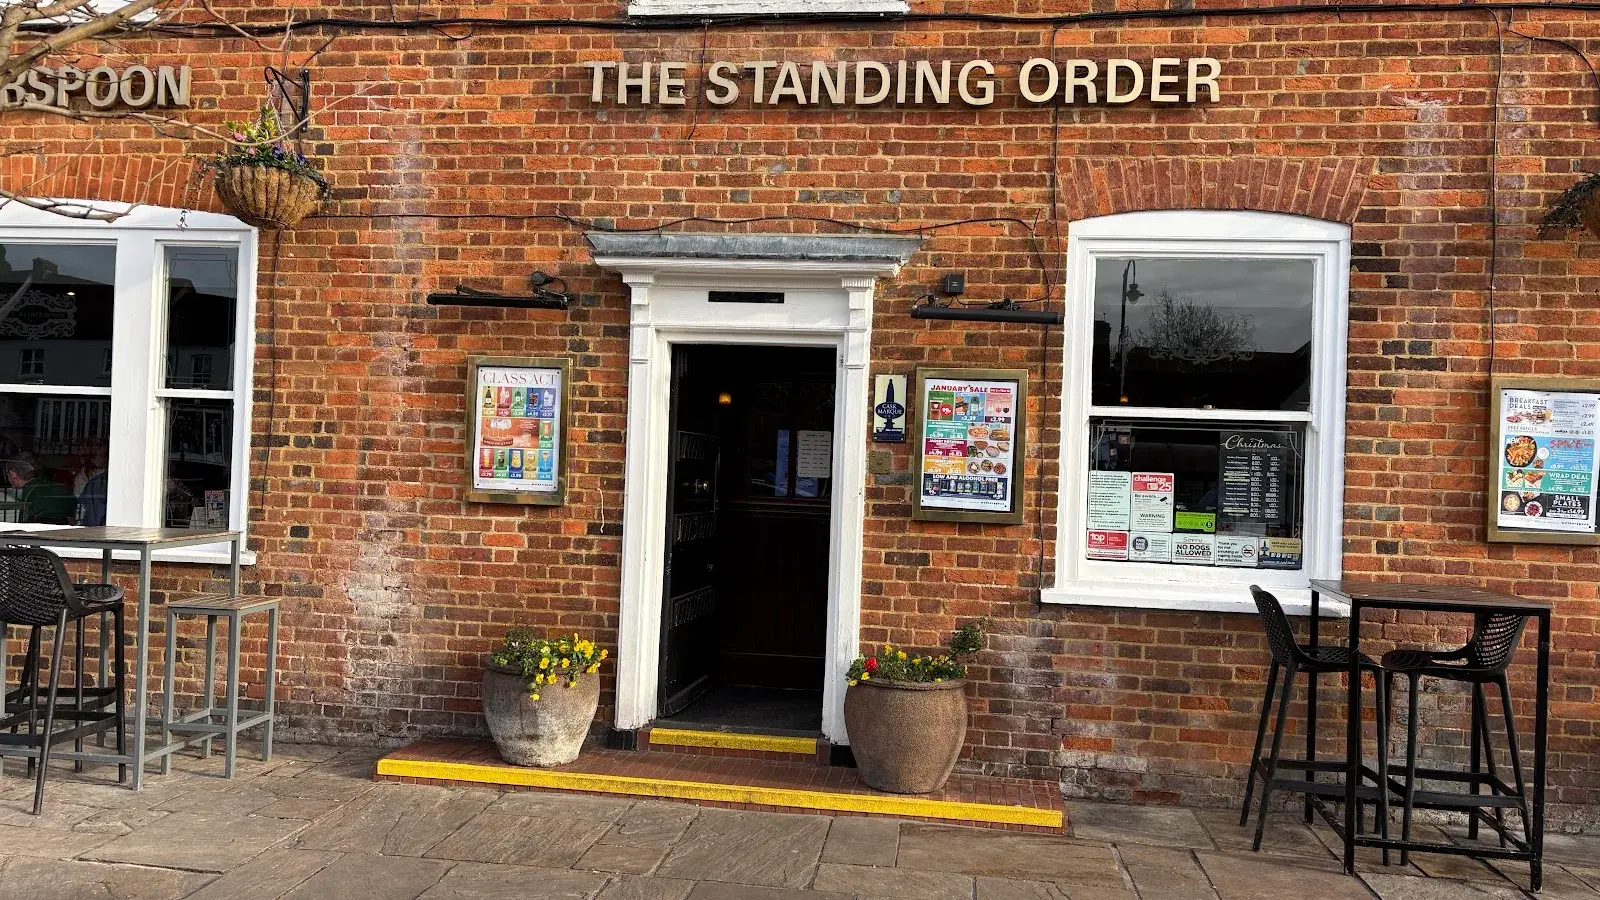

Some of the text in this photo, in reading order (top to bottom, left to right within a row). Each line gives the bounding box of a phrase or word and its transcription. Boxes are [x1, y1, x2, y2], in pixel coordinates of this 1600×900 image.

[584, 58, 1222, 106] THE STANDING ORDER
[483, 372, 558, 385] CLASS ACT
[930, 384, 968, 392] JANUARY
[1509, 397, 1548, 405] BREAKFAST
[1220, 434, 1287, 450] Christmas
[1134, 474, 1167, 484] challenge
[1158, 481, 1172, 491] 25
[1089, 532, 1105, 542] top
